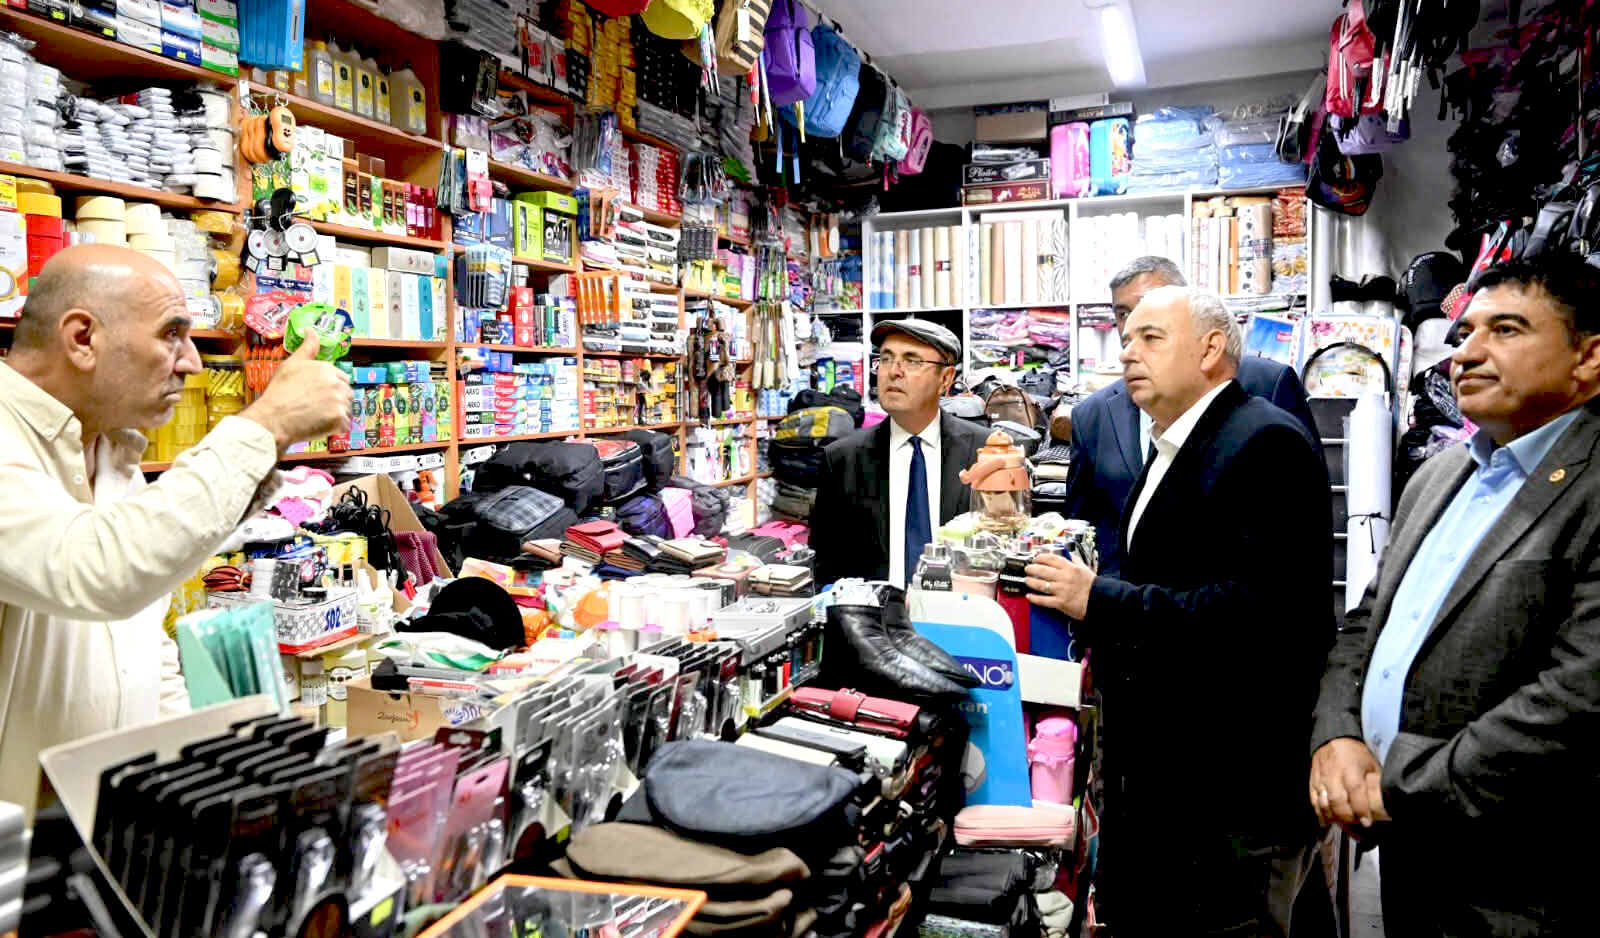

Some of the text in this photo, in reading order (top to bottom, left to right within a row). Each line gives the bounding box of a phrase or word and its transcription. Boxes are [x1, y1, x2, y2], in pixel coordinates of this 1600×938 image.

[467, 401, 480, 409] ARKO
[466, 427, 480, 435] ARKO
[962, 664, 1004, 685] NO
